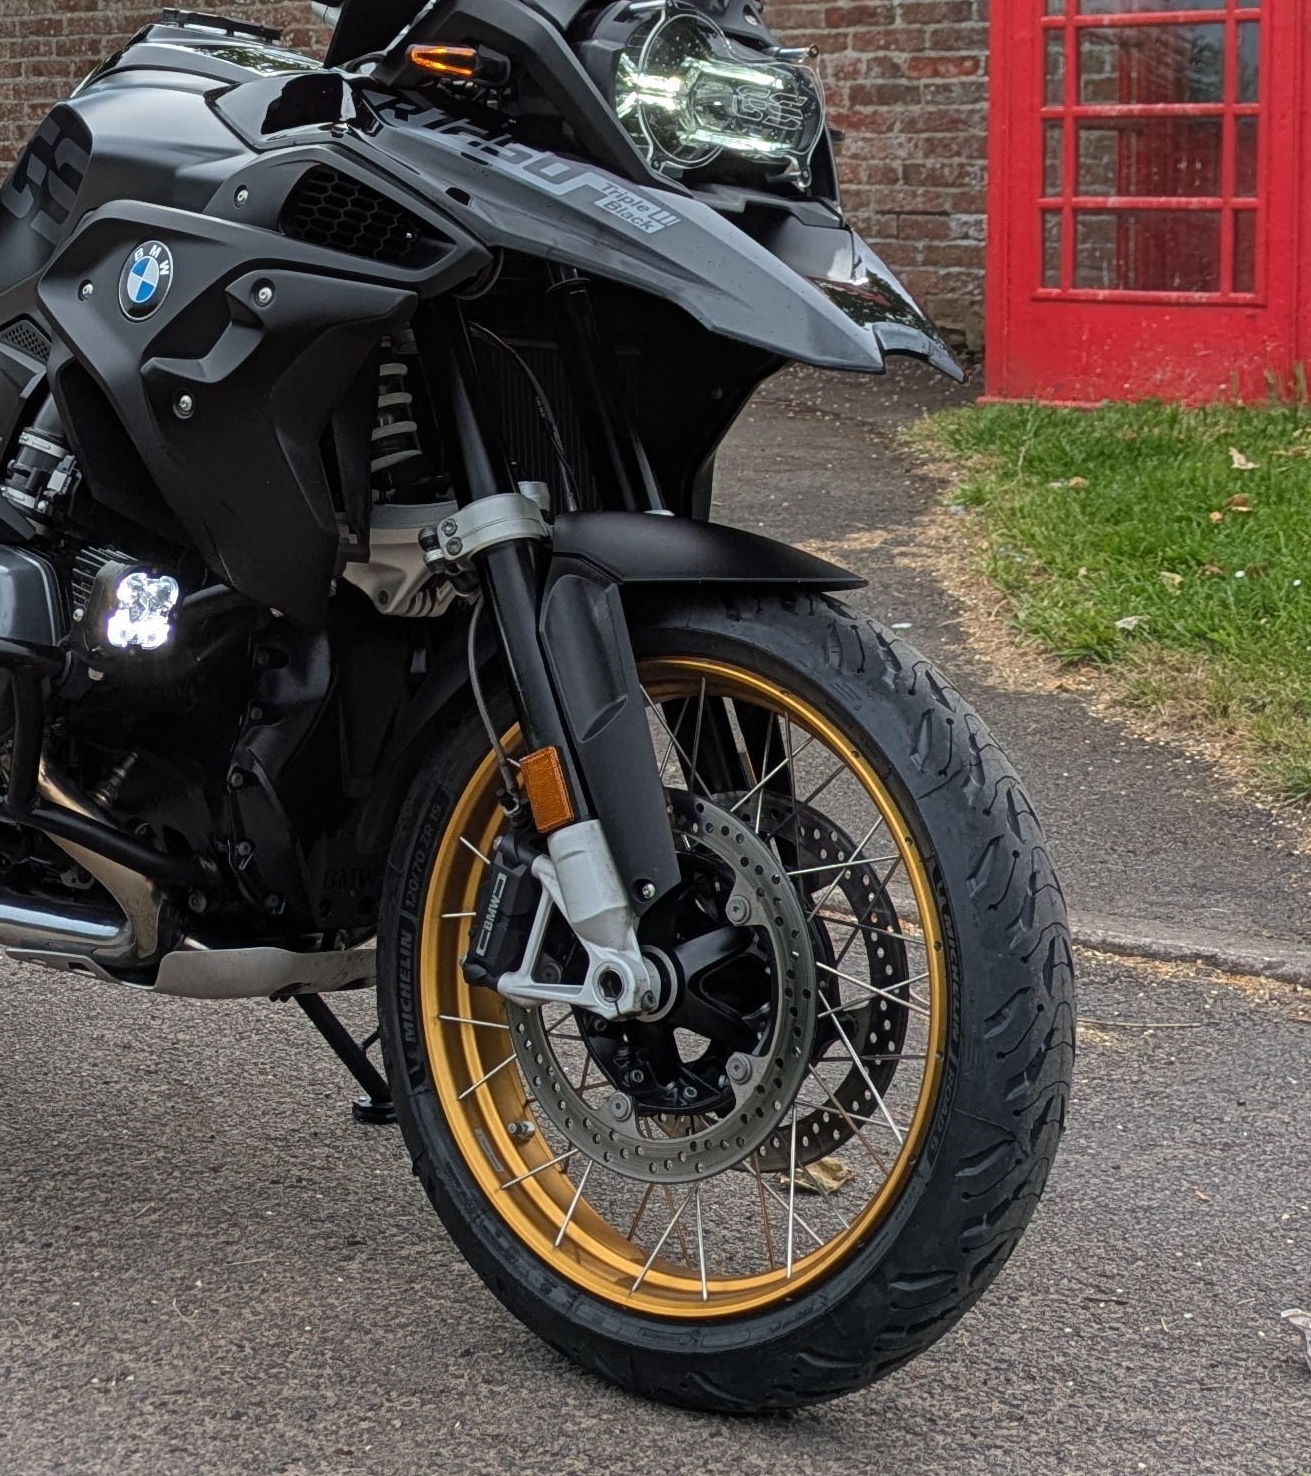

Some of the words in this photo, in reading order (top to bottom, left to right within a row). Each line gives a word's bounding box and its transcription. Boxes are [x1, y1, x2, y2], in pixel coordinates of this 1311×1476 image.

[601, 181, 650, 213] Triple
[602, 199, 655, 231] Black
[134, 244, 170, 276] BMW
[404, 850, 427, 910] 120/70
[483, 894, 501, 932] BMW
[398, 929, 414, 1043] MICHELIN
[944, 912, 961, 1045] MICHELIN
